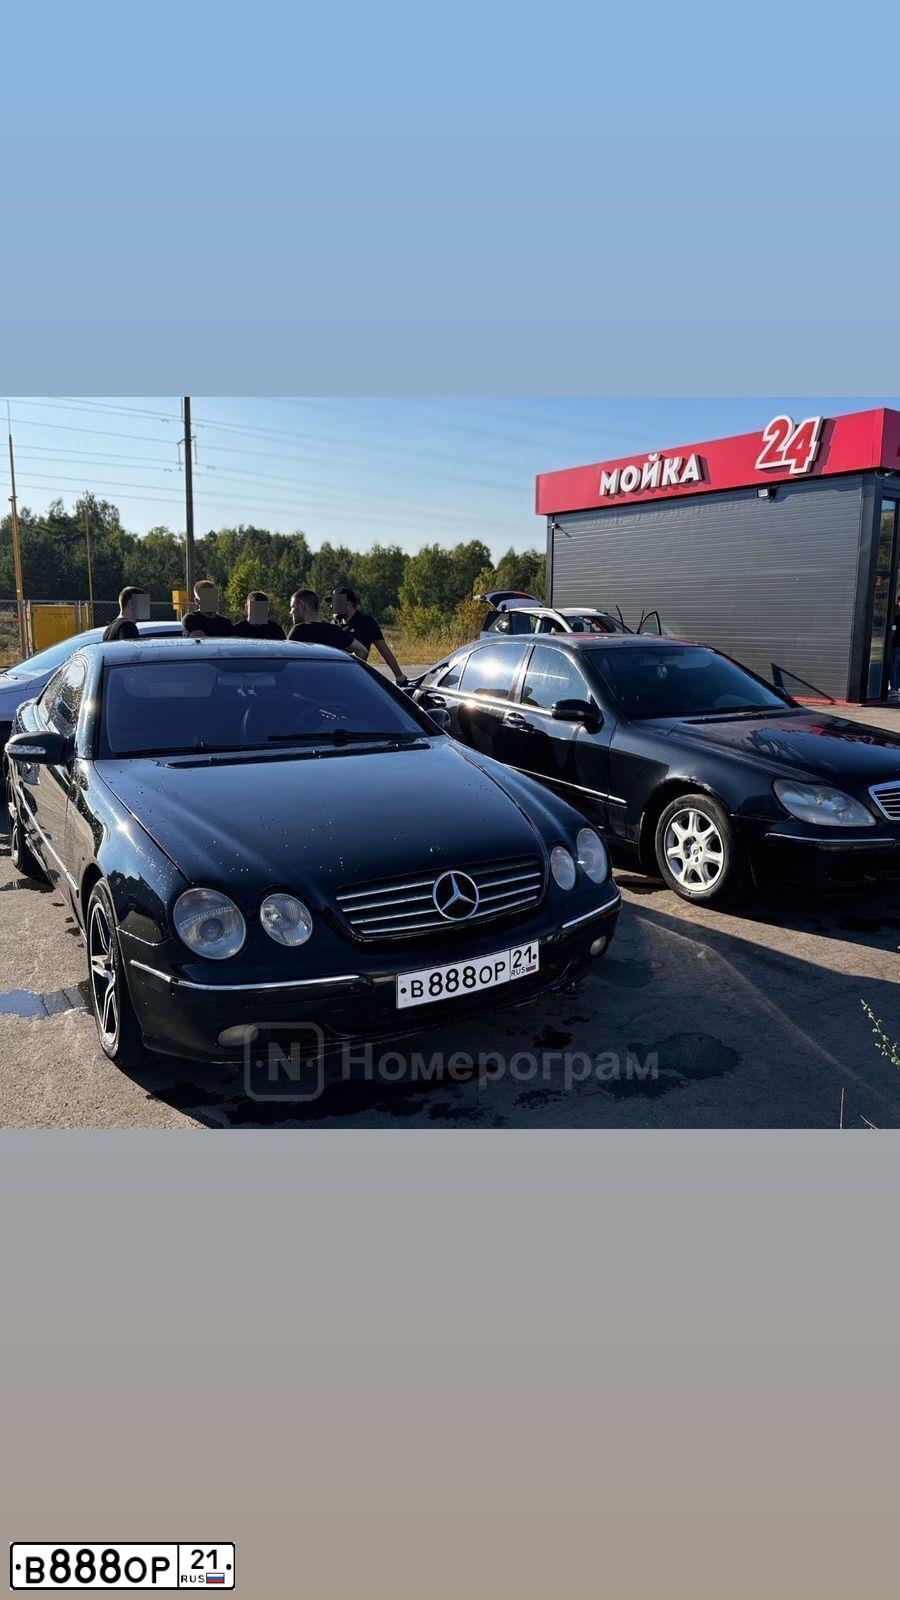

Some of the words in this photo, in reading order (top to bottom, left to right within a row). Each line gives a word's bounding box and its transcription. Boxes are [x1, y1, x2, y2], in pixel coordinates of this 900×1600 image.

[600, 453, 702, 496] МОЙКА
[755, 415, 823, 475] 24
[513, 946, 532, 968] 21
[511, 966, 526, 976] RUS
